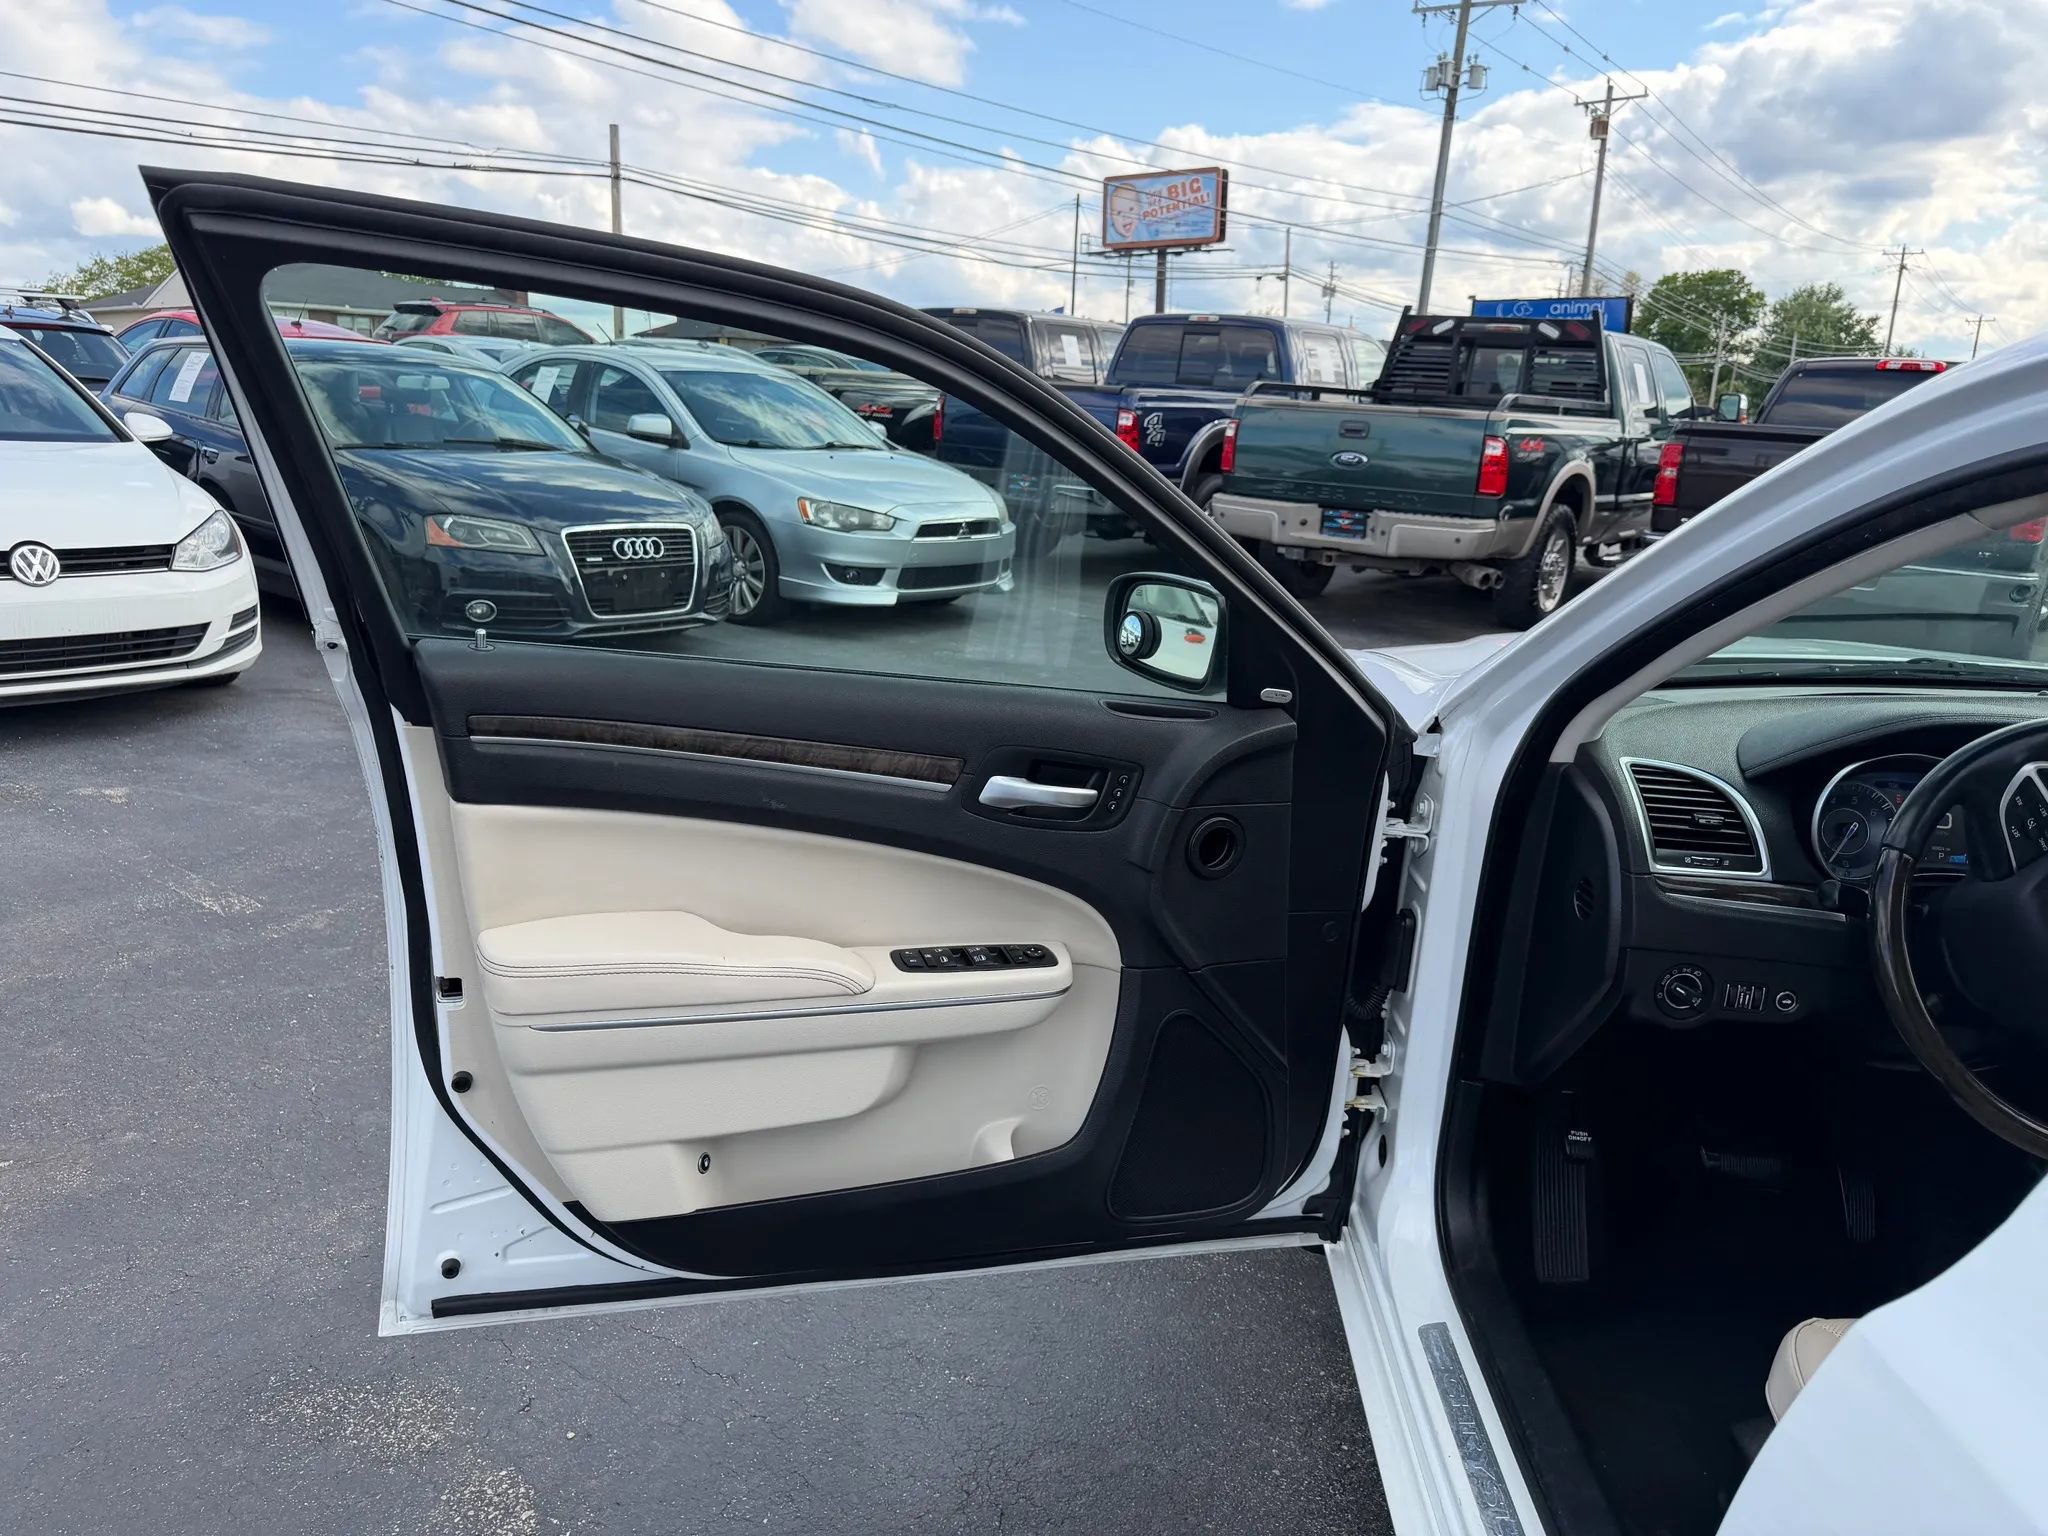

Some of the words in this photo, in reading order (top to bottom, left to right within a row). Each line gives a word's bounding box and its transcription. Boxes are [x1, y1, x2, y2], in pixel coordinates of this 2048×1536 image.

[1167, 177, 1201, 199] BIG
[1550, 300, 1605, 315] animal
[1443, 1372, 1516, 1536] CHRYSL
